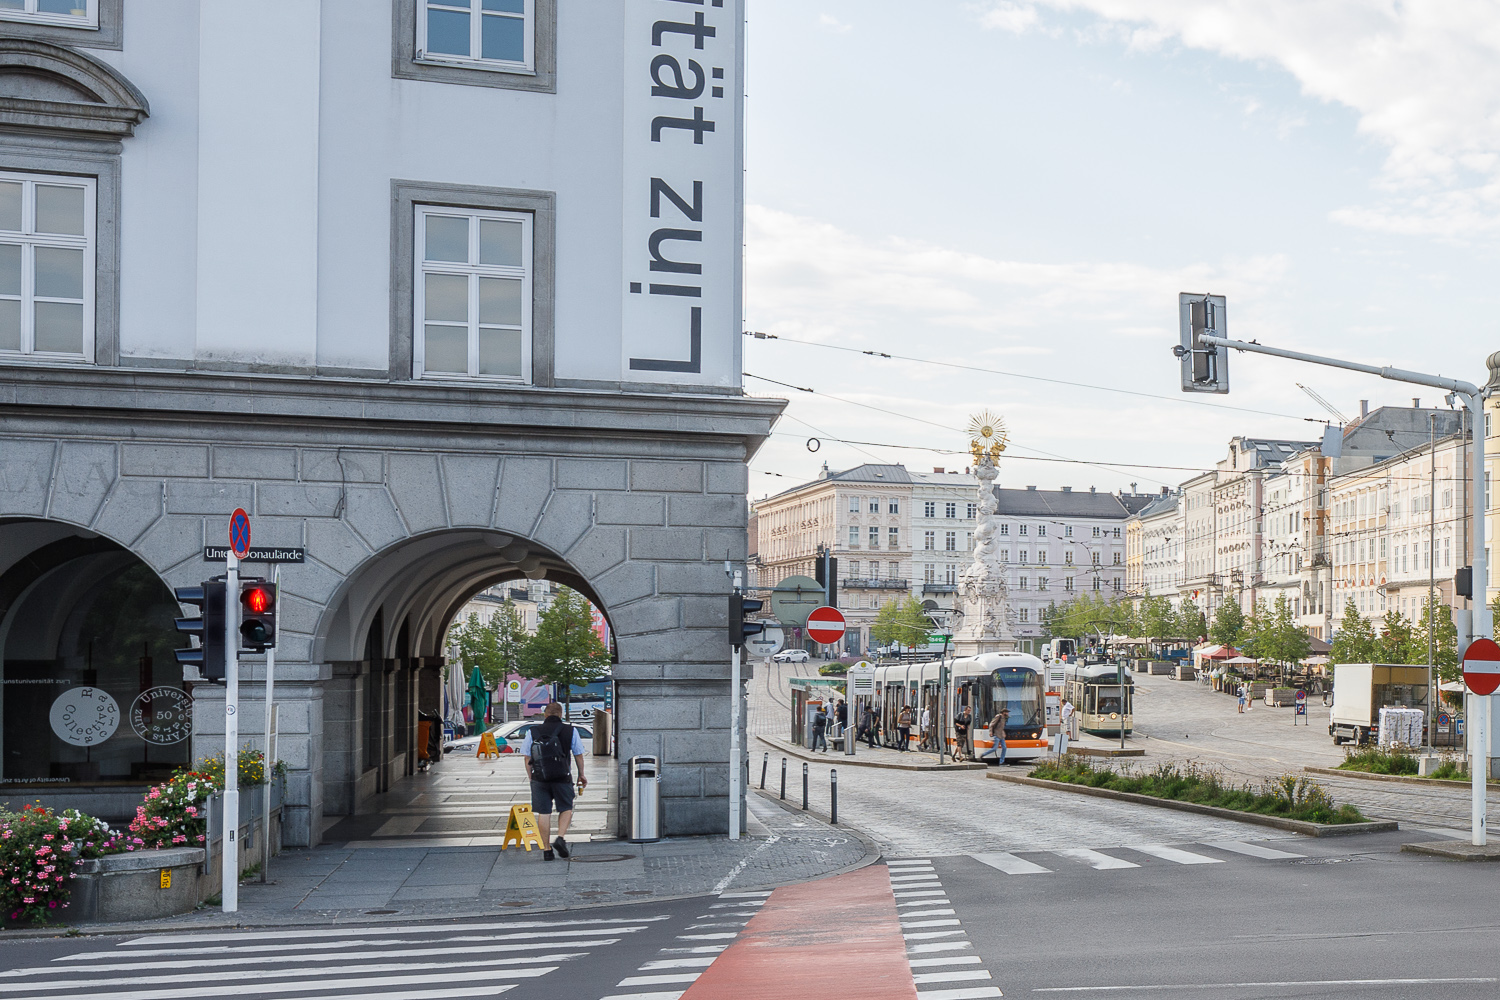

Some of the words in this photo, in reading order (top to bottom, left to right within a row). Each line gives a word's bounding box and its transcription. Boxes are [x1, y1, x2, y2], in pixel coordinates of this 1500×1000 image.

[629, 177, 703, 374] Linz
[206, 548, 229, 559] Unte
[246, 549, 303, 560] onaulände
[156, 710, 173, 720] 50
